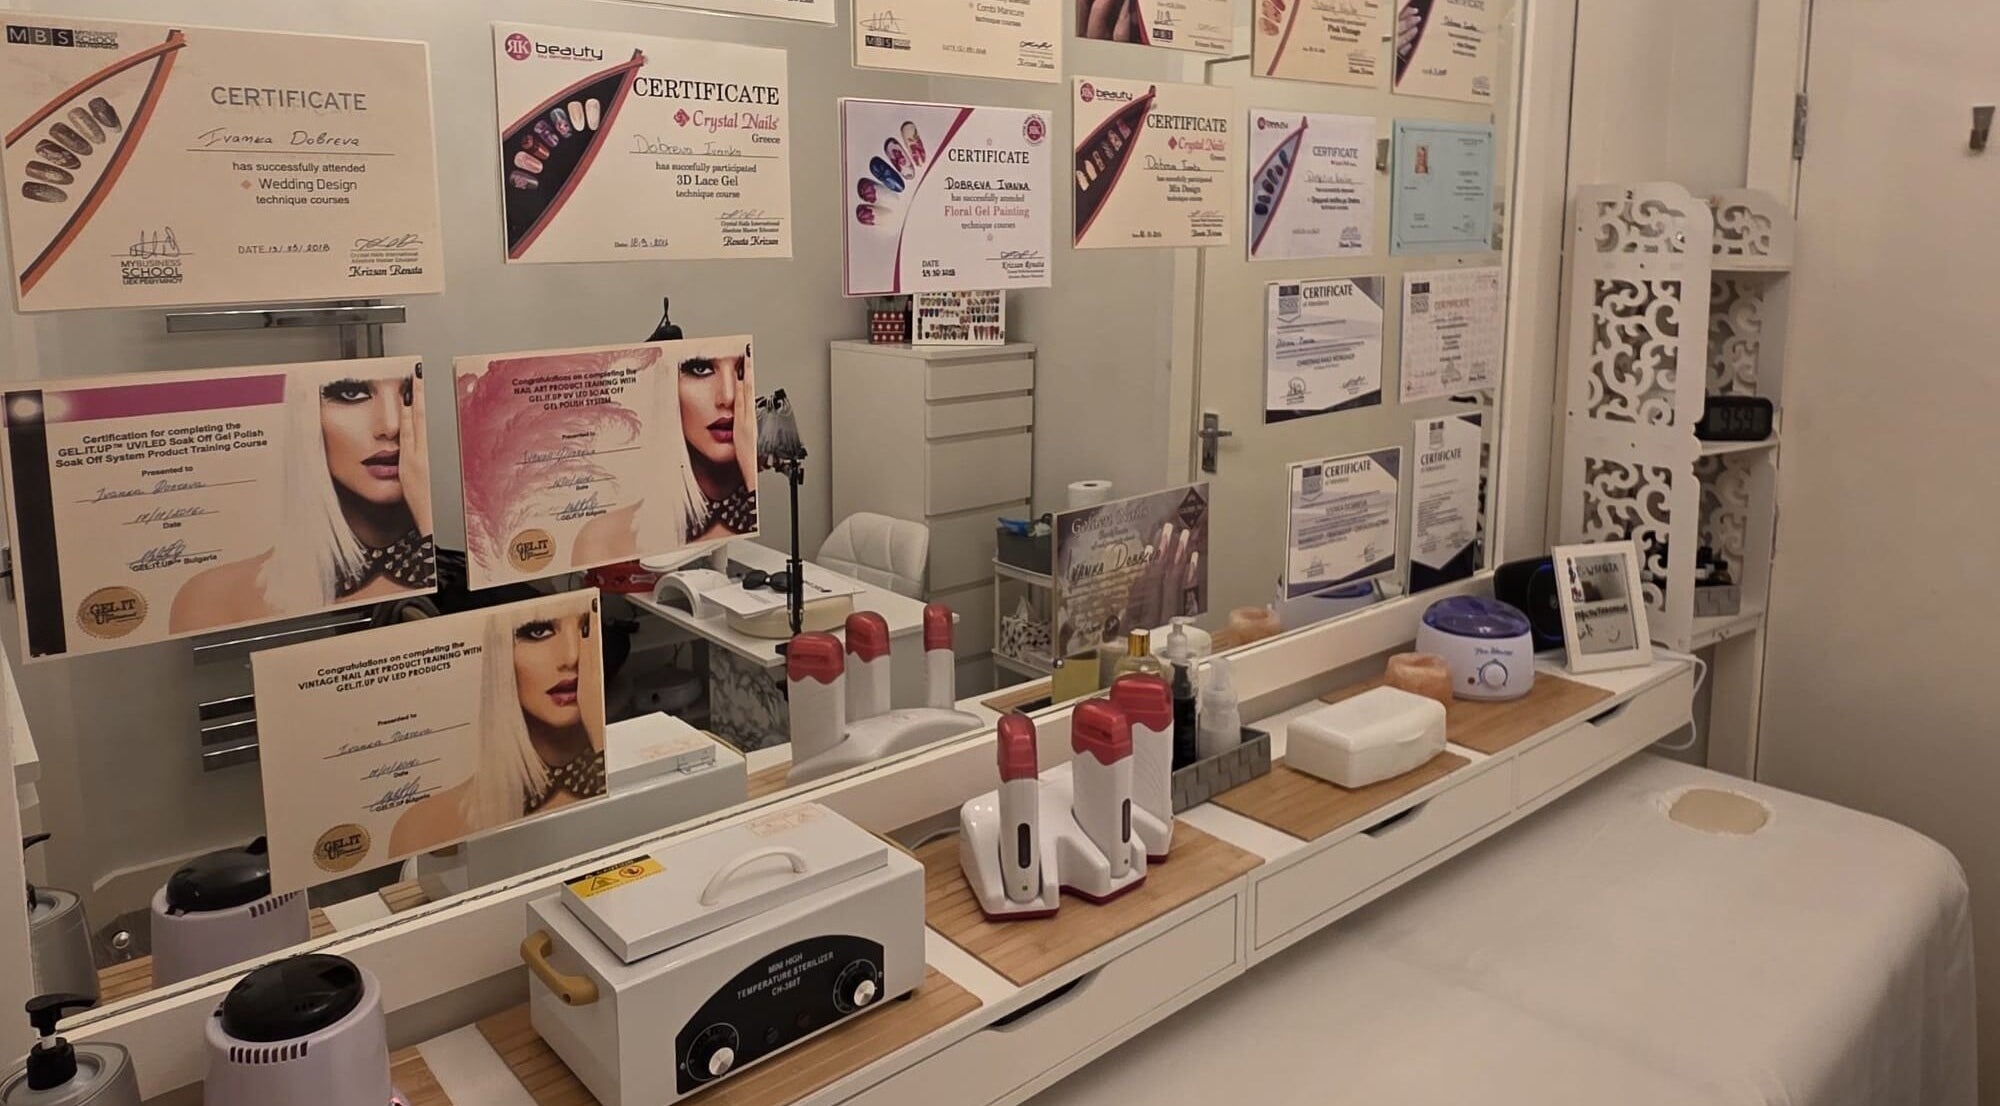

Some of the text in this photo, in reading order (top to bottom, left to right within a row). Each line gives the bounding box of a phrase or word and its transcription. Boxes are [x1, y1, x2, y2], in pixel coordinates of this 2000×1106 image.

[535, 42, 602, 60] beauty
[211, 86, 367, 111] CERTIFICATE
[632, 77, 780, 105] CERTIFICATE
[692, 110, 780, 134] Crystal Nails
[1146, 114, 1227, 133] CERTIFICATE
[751, 134, 781, 144] Greece
[948, 149, 1030, 164] CERTIFICATE
[1313, 146, 1358, 158] CERTIFICATE
[233, 162, 366, 174] has successfully attended
[656, 161, 670, 171] has
[712, 164, 757, 173] participated
[258, 178, 358, 192] Wedding Design
[676, 175, 738, 186] 3D Lace Gel
[256, 195, 350, 205] technique courses
[675, 190, 740, 199] technique course
[945, 206, 1030, 218] Floral Gel Painting
[238, 245, 264, 254] DATE
[122, 267, 183, 277] SCHOOL
[1303, 284, 1352, 299] CERTIFICATE
[512, 374, 571, 386] Congratulations
[584, 369, 625, 380] completing
[514, 387, 532, 395] NAIL
[550, 382, 583, 392] PRODUCT
[585, 378, 618, 388] TRAINING
[576, 390, 588, 398] LED
[612, 387, 624, 395] OFF
[544, 402, 558, 411] GEL
[559, 400, 584, 409] POLISH
[82, 422, 241, 445] Certification for completing the
[127, 439, 166, 450] UV/LED
[169, 435, 194, 446] Soak
[197, 434, 212, 443] Off
[215, 432, 231, 441] Gel
[234, 429, 264, 439] Polish
[55, 439, 268, 468] Soak Off System Product Training Course
[1420, 448, 1461, 466] CERTIFICATE
[142, 466, 183, 477] Presented
[1325, 460, 1371, 478] CERTIFICATE
[163, 521, 181, 529] Date
[317, 641, 465, 677] Congratulations on completing the
[298, 646, 482, 690] VINTAGE NAIL ART PRODUCT TRAINING WITH
[377, 675, 390, 684] UV
[392, 672, 407, 681] LED
[408, 662, 452, 678] PRODUCTS
[785, 953, 803, 966] HIGH
[737, 951, 834, 1000] TEMPERATURE STERILIZER
